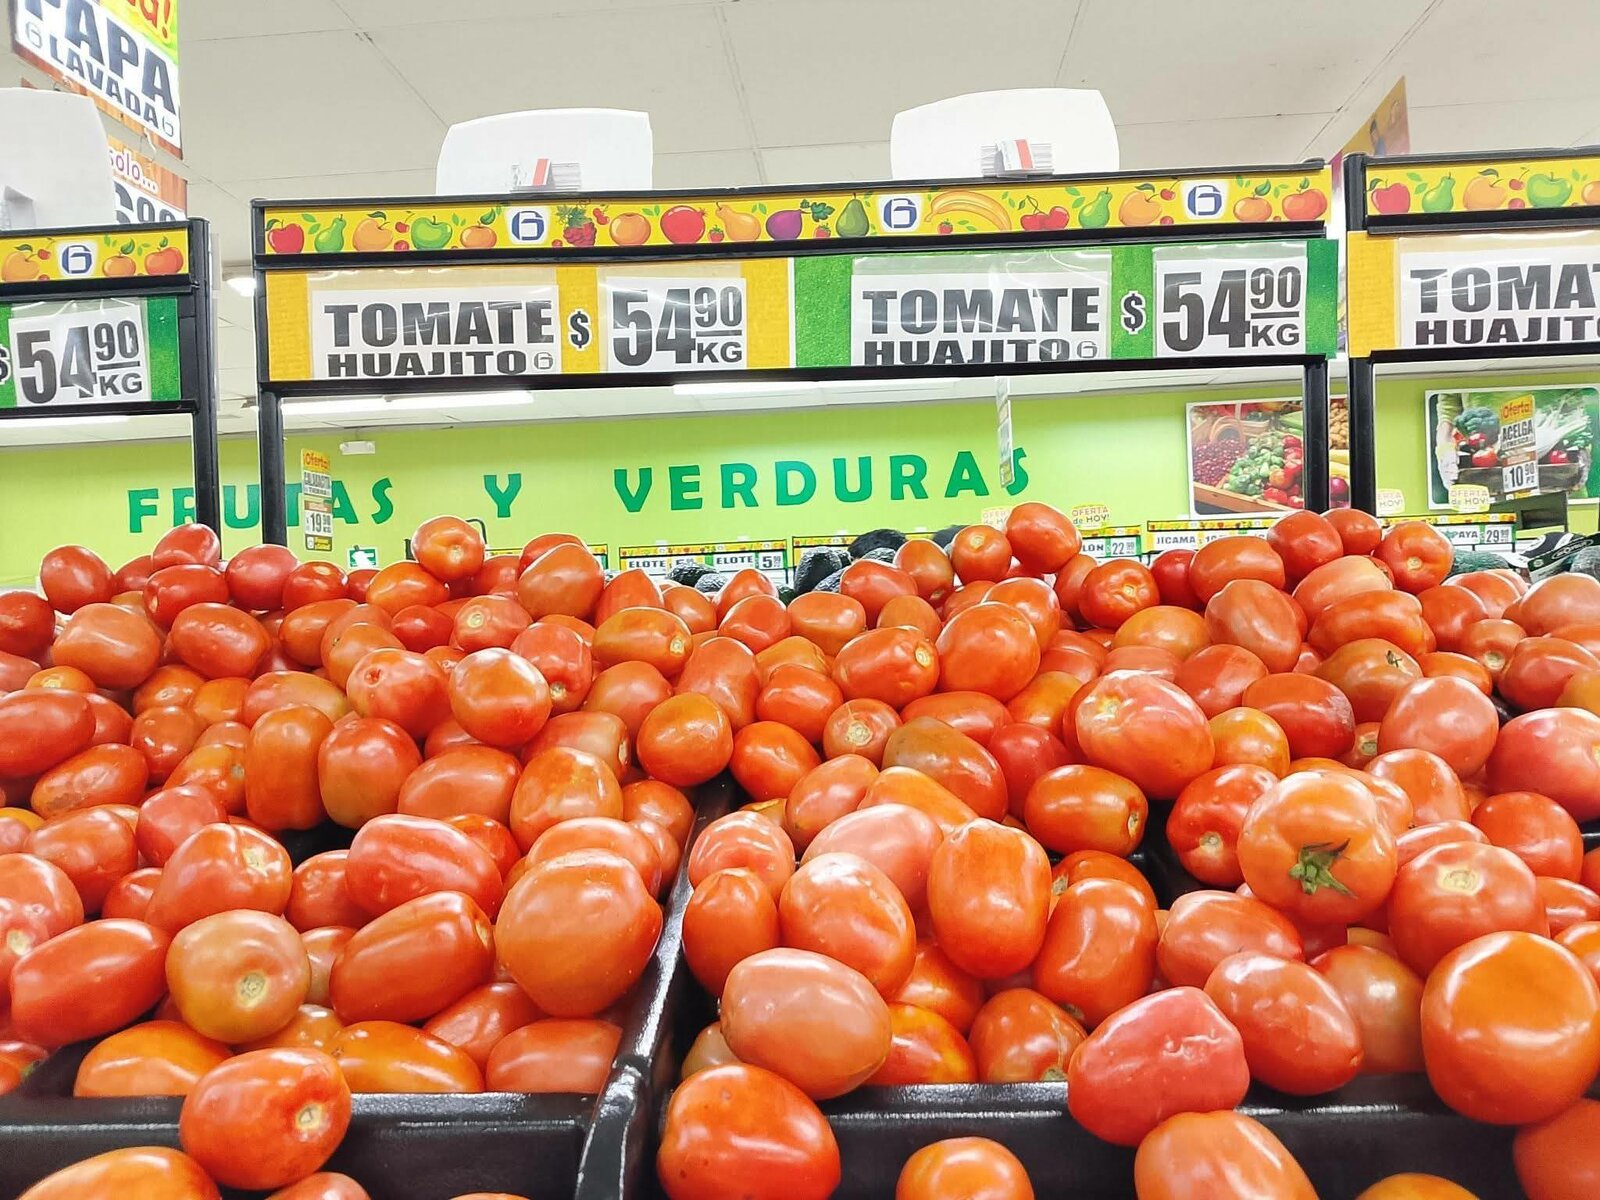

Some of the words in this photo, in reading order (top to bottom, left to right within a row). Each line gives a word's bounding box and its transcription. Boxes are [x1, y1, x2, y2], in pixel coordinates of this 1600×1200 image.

[50, 35, 159, 129] LAVADA
[1410, 263, 1600, 313] TOMA
[862, 288, 1099, 334] TOMATE
[324, 300, 554, 347] TOMATE
[1415, 315, 1600, 345] HUAJIT
[1251, 323, 1300, 347] KG
[697, 341, 742, 363] KG
[864, 339, 1070, 365] HUAJITO
[327, 350, 527, 377] HUAJITO
[99, 373, 142, 396] KG
[1502, 420, 1533, 441] ACELGA
[483, 473, 521, 518] Y
[614, 447, 1028, 512] VERDURAS
[1509, 466, 1524, 488] 10
[310, 513, 322, 533] 19
[1072, 507, 1108, 517] OFERTA
[1157, 535, 1196, 544] JICAMA
[1487, 530, 1500, 543] 29
[1082, 544, 1104, 552] LON
[1112, 542, 1125, 555] 22
[628, 558, 665, 569] ELOTE
[716, 556, 753, 565] ELOTE
[762, 556, 773, 568] 5
